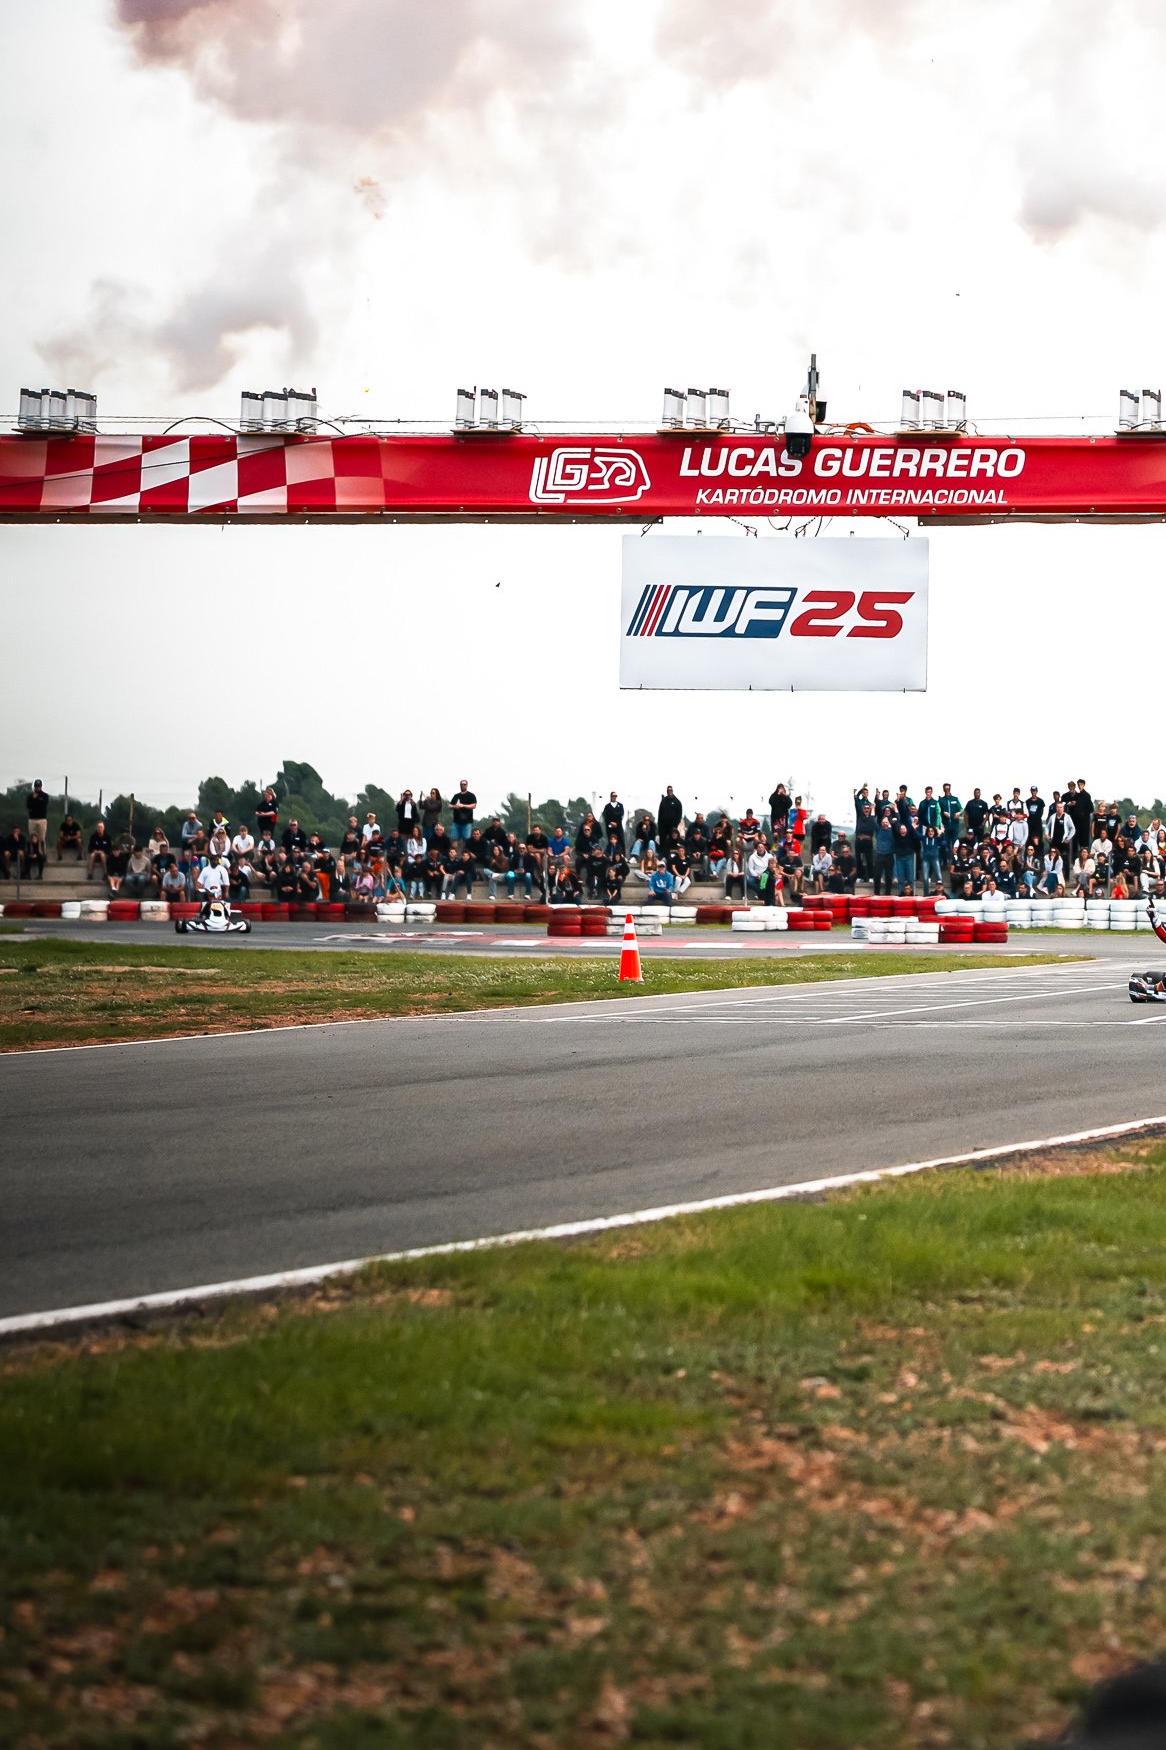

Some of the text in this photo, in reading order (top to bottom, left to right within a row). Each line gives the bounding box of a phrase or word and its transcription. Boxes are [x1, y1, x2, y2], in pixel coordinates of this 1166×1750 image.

[679, 447, 1026, 478] LUCAS GUERRERO
[695, 485, 1009, 505] KARTÓDROMO INTERNACIONAL
